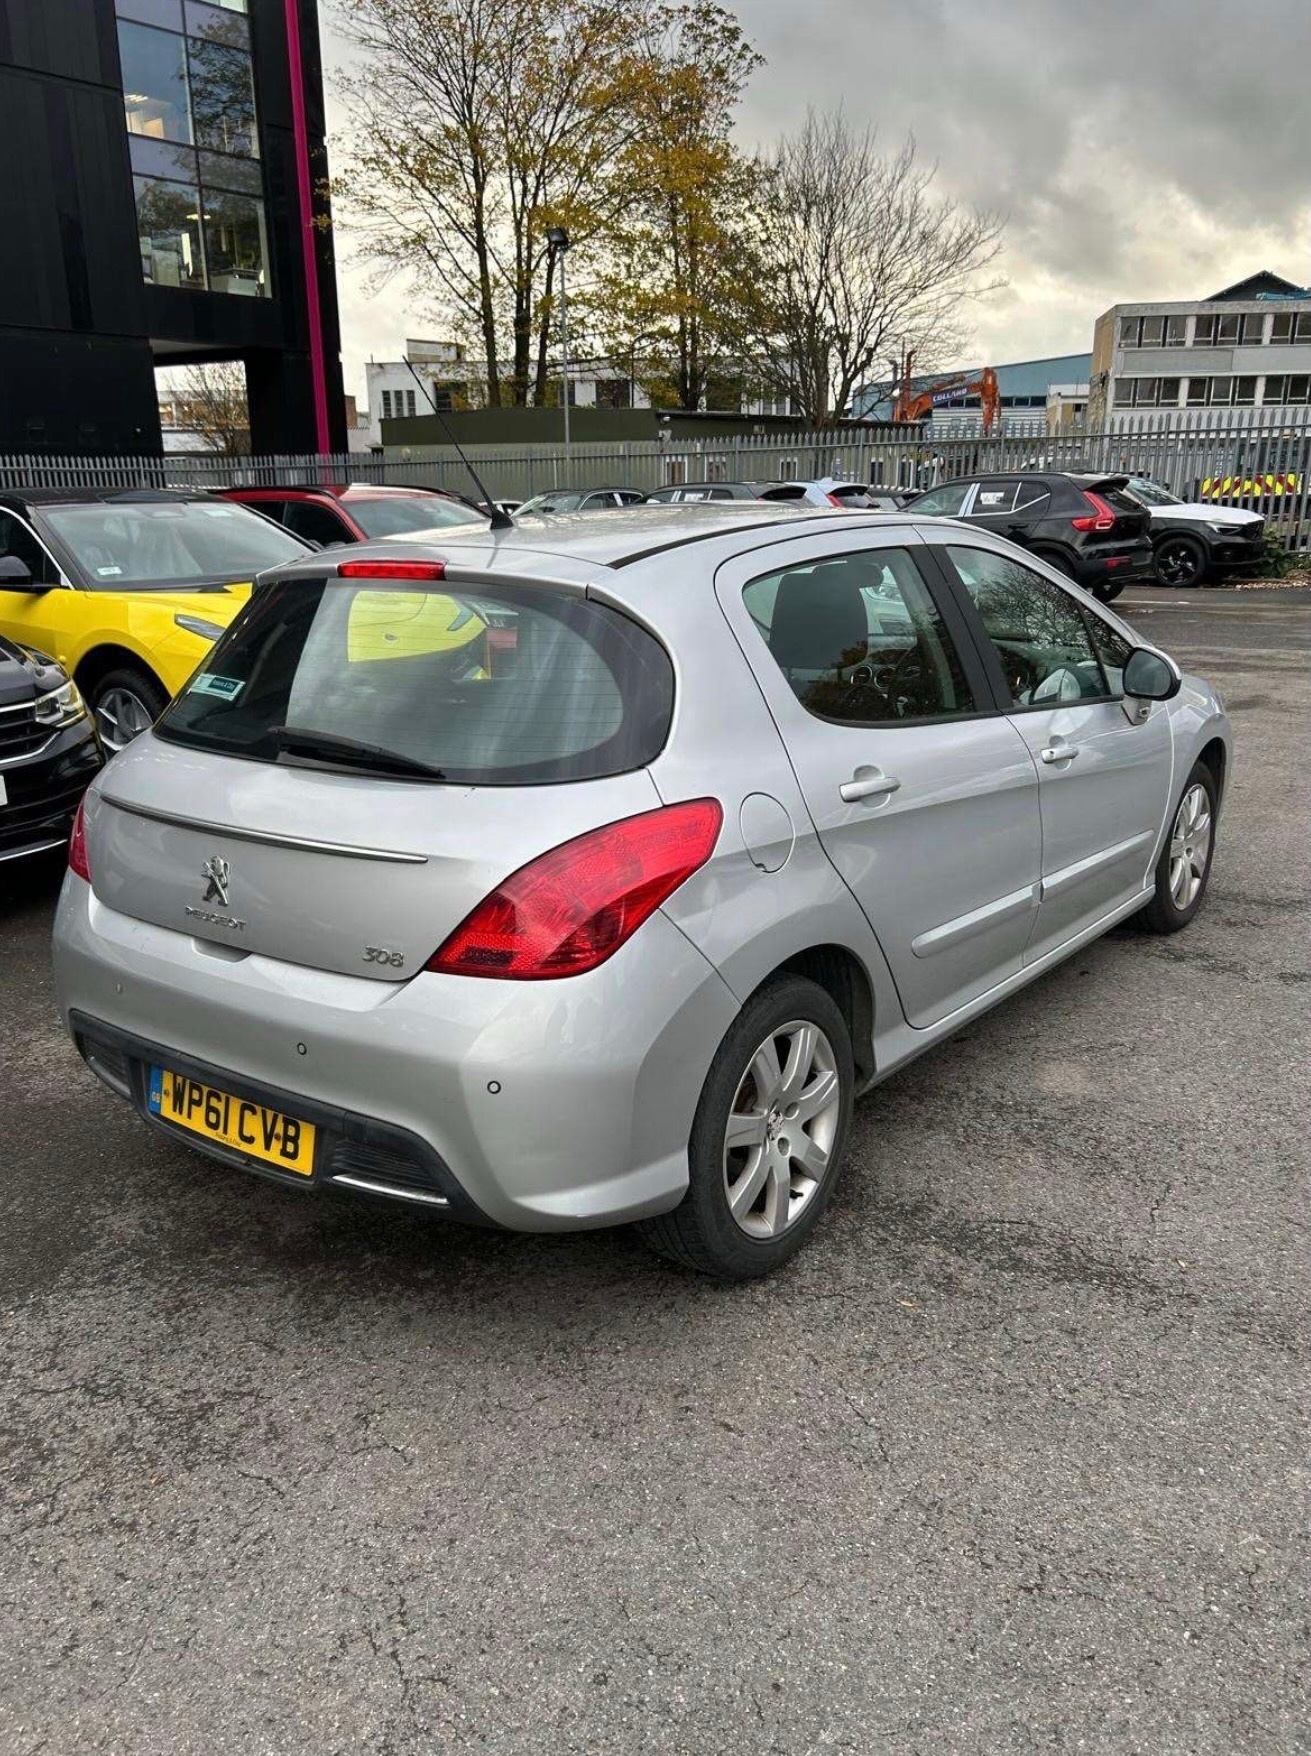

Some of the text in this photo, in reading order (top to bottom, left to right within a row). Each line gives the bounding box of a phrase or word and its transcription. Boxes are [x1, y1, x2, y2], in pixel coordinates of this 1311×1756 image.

[185, 906, 246, 931] PEUGEOT
[362, 946, 403, 968] 308
[171, 1073, 301, 1161] WP61 CVB
